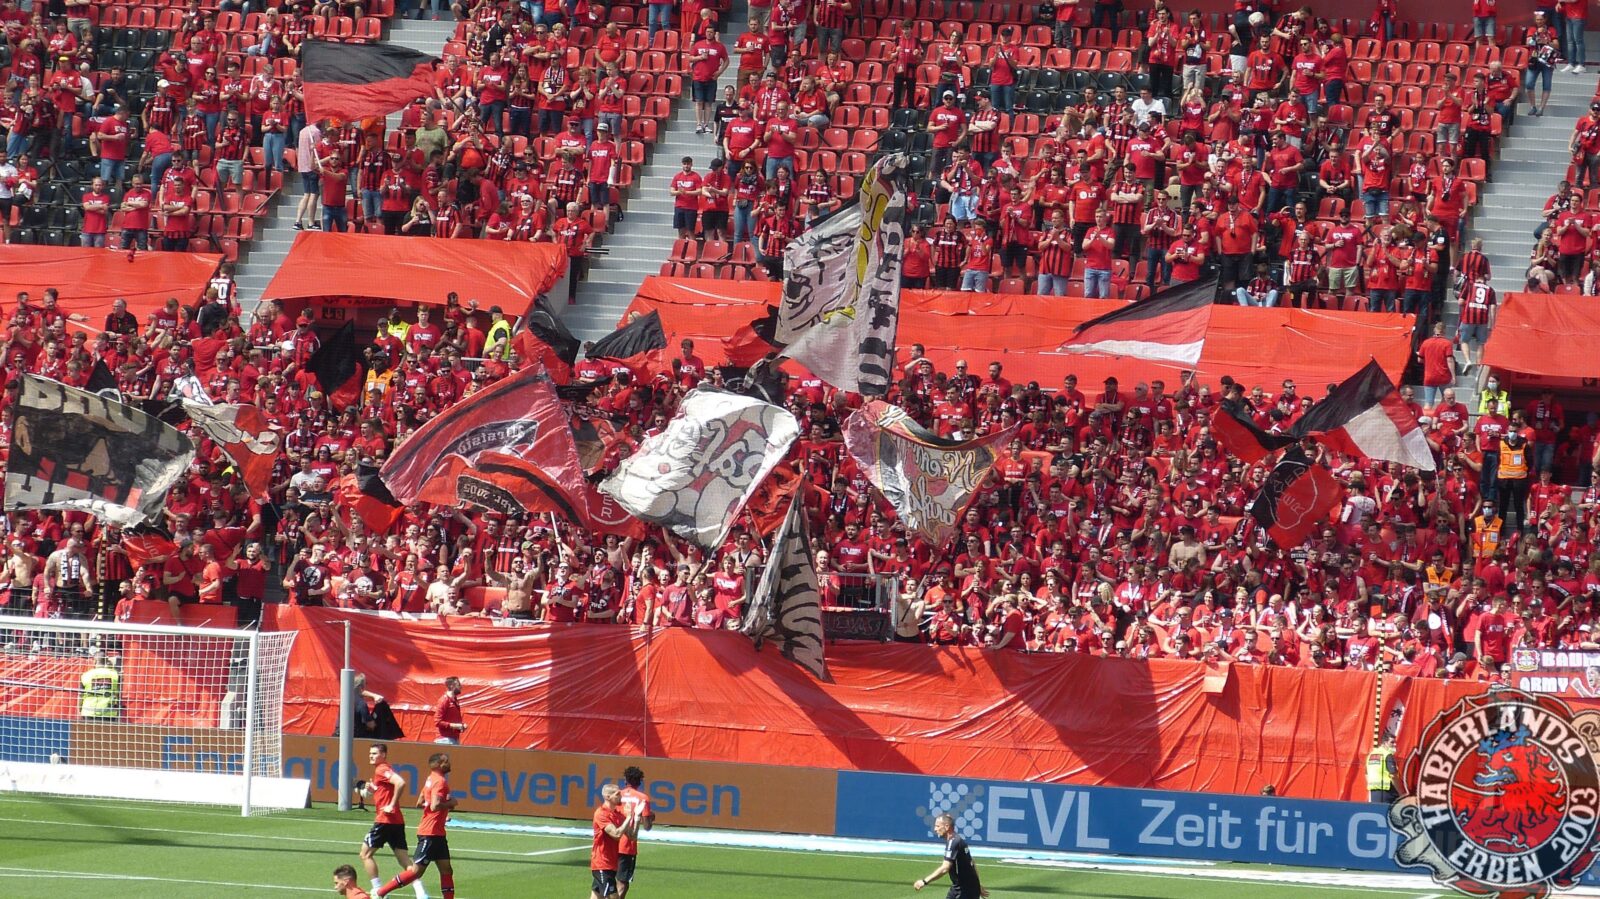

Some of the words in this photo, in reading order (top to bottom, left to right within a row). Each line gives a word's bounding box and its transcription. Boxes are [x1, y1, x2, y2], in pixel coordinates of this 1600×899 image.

[1475, 287, 1486, 304] 9
[1520, 677, 1569, 692] ARMY
[444, 763, 741, 818] everksen
[986, 786, 1110, 850] EVL
[1138, 798, 1242, 850] Zeit
[1255, 806, 1332, 855] für
